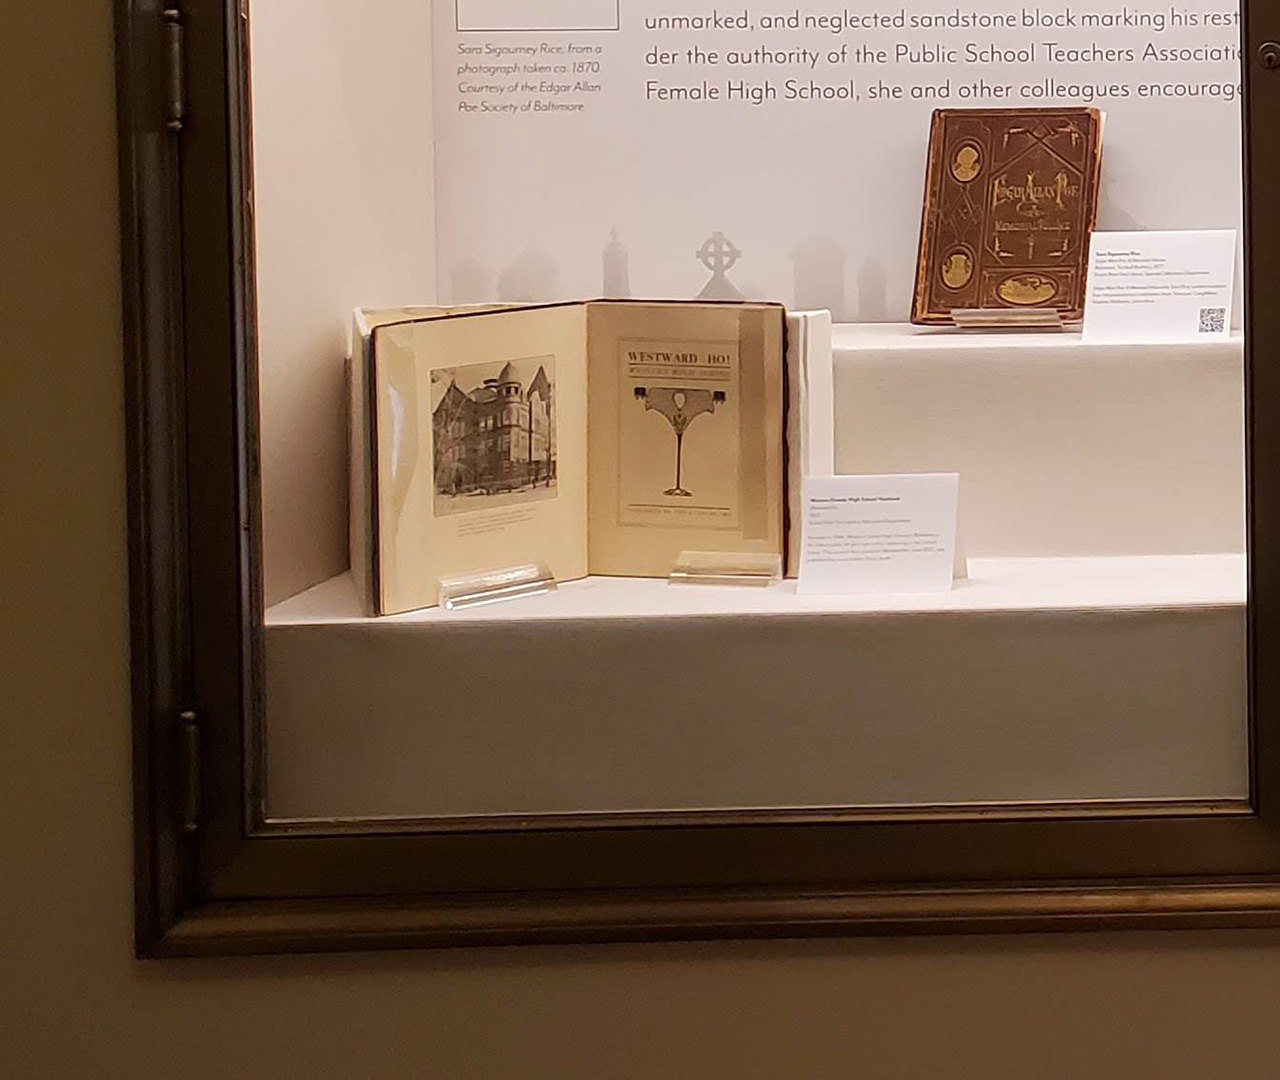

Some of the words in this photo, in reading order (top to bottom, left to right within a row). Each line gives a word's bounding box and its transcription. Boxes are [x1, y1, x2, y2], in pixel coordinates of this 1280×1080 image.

[644, 8, 755, 32] unmarked,
[759, 8, 800, 29] and
[804, 8, 905, 35] neglected
[909, 7, 1017, 29] sandstone
[1021, 7, 1077, 28] block
[1081, 6, 1165, 32] marking
[1170, 6, 1199, 27] his
[457, 42, 483, 55] Sara
[484, 42, 538, 57] Sigourney
[567, 42, 593, 54] from
[457, 62, 520, 76] photograph
[523, 63, 551, 74] taken
[458, 81, 505, 95] Courtesy
[507, 81, 519, 93] of
[521, 82, 537, 93] the
[539, 81, 571, 95] Edgar
[573, 81, 602, 92] Allan
[646, 80, 720, 101] Female
[727, 79, 777, 106] High
[784, 79, 860, 102] School,
[868, 79, 903, 100] she
[910, 78, 950, 99] and
[958, 78, 1013, 99] other
[1019, 77, 1130, 103] colleagues
[458, 101, 479, 112] Poe
[480, 101, 518, 114] Society
[520, 101, 532, 112] of
[628, 352, 698, 364] WESTWARD
